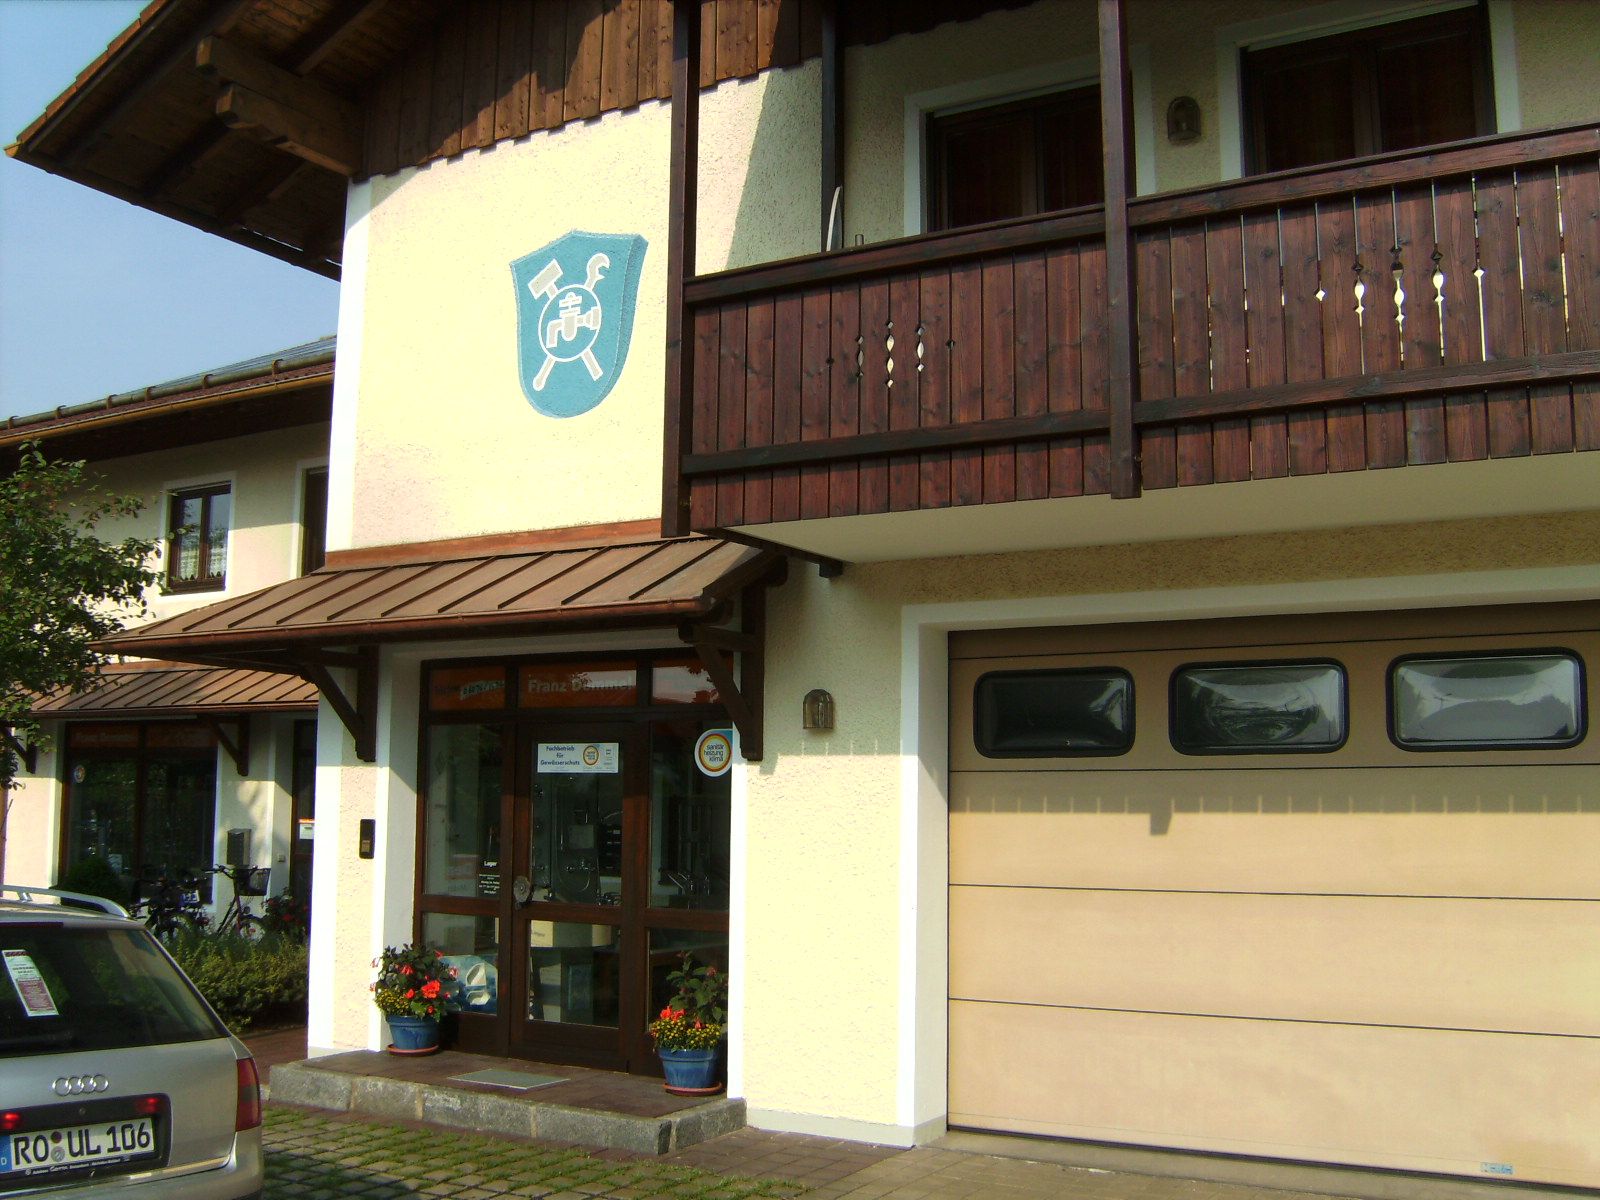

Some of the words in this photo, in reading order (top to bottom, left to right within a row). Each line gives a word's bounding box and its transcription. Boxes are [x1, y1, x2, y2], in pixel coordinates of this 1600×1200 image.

[528, 679, 566, 692] Franz
[13, 1135, 50, 1165] RO
[67, 1128, 102, 1157] UL
[106, 1121, 151, 1153] 106
